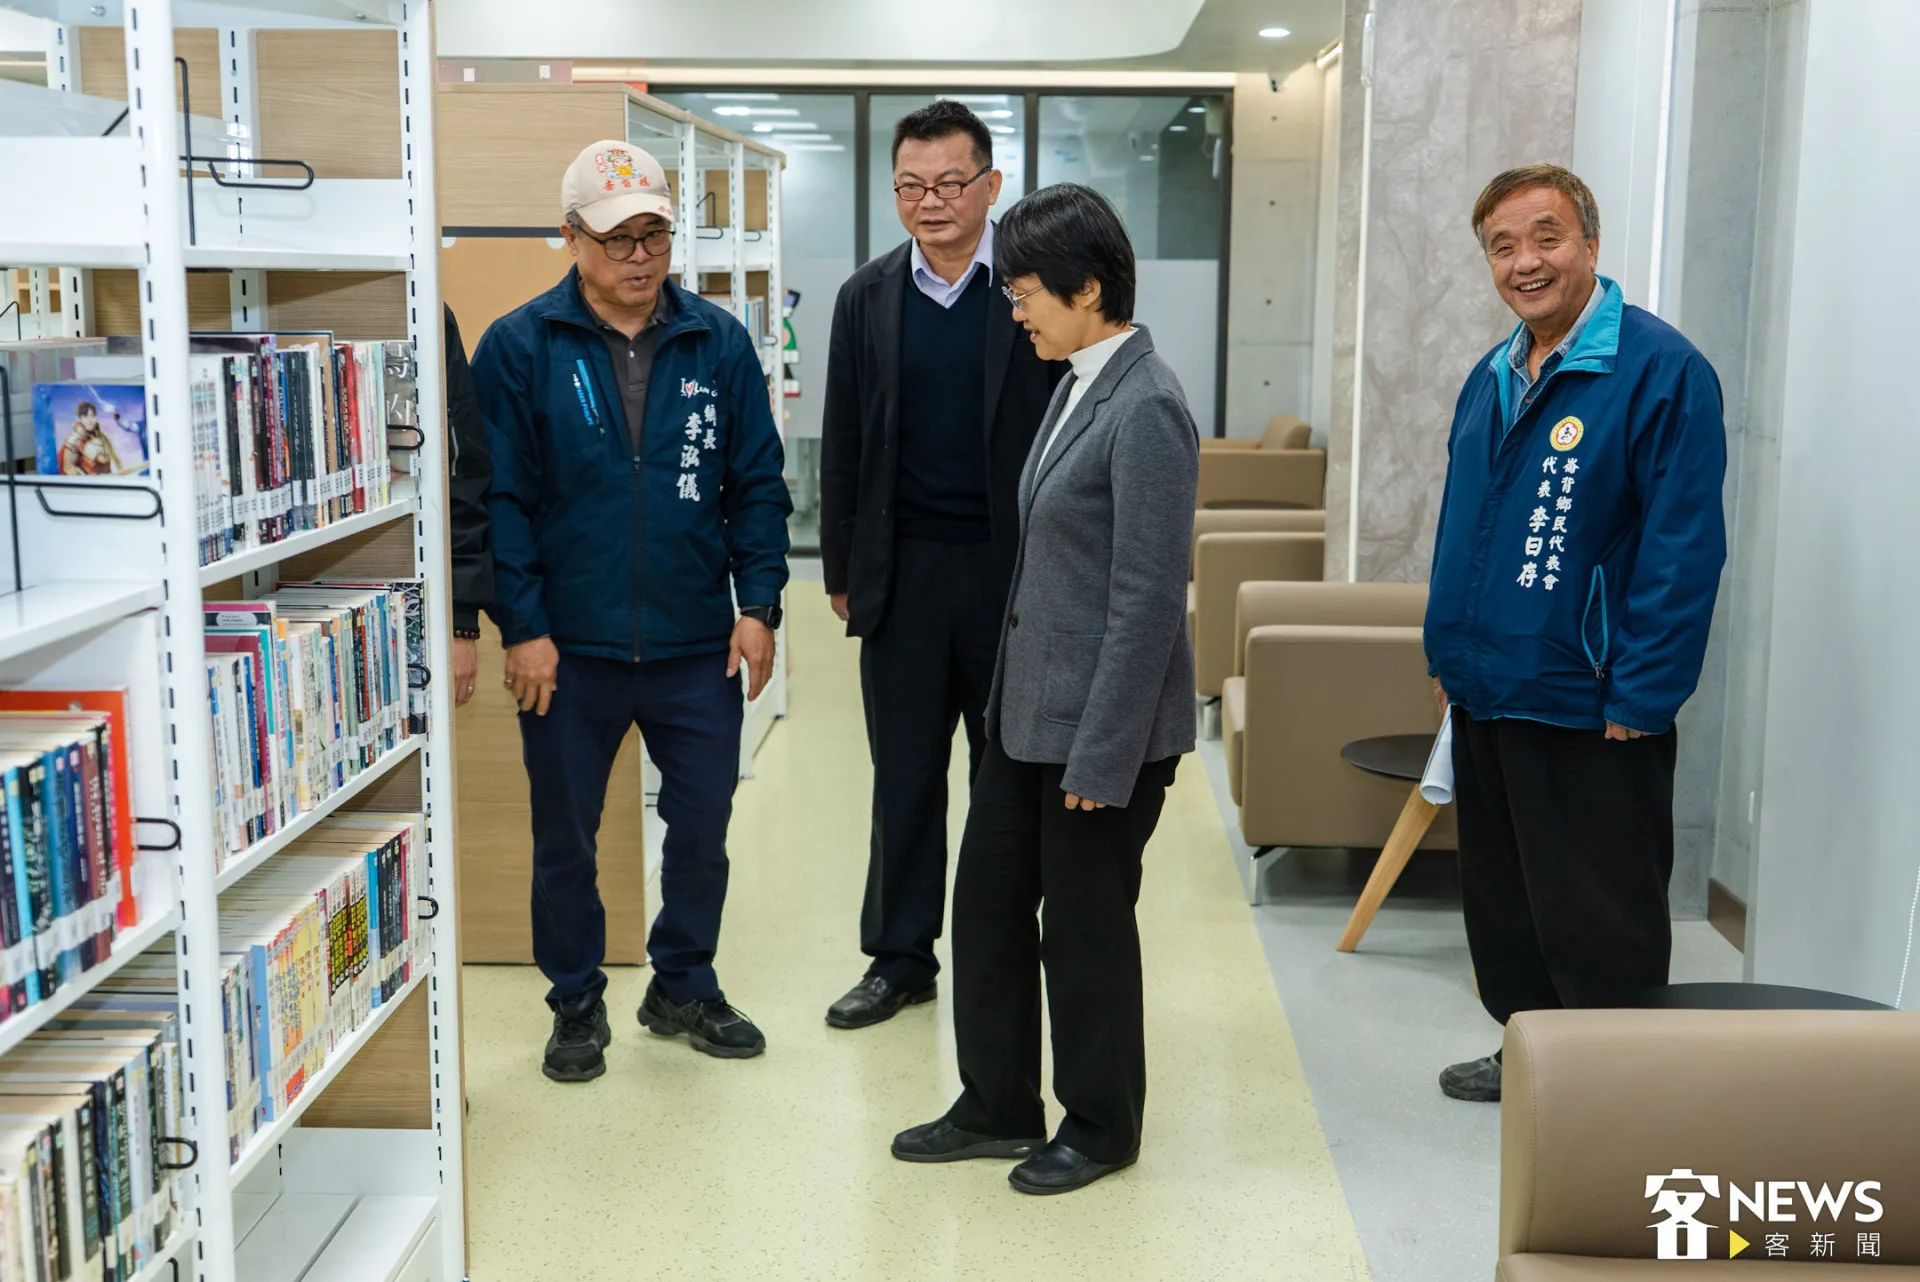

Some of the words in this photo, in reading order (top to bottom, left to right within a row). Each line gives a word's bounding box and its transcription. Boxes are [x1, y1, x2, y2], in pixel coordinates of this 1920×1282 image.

[1541, 457, 1580, 591] 崙背鄉民代表會
